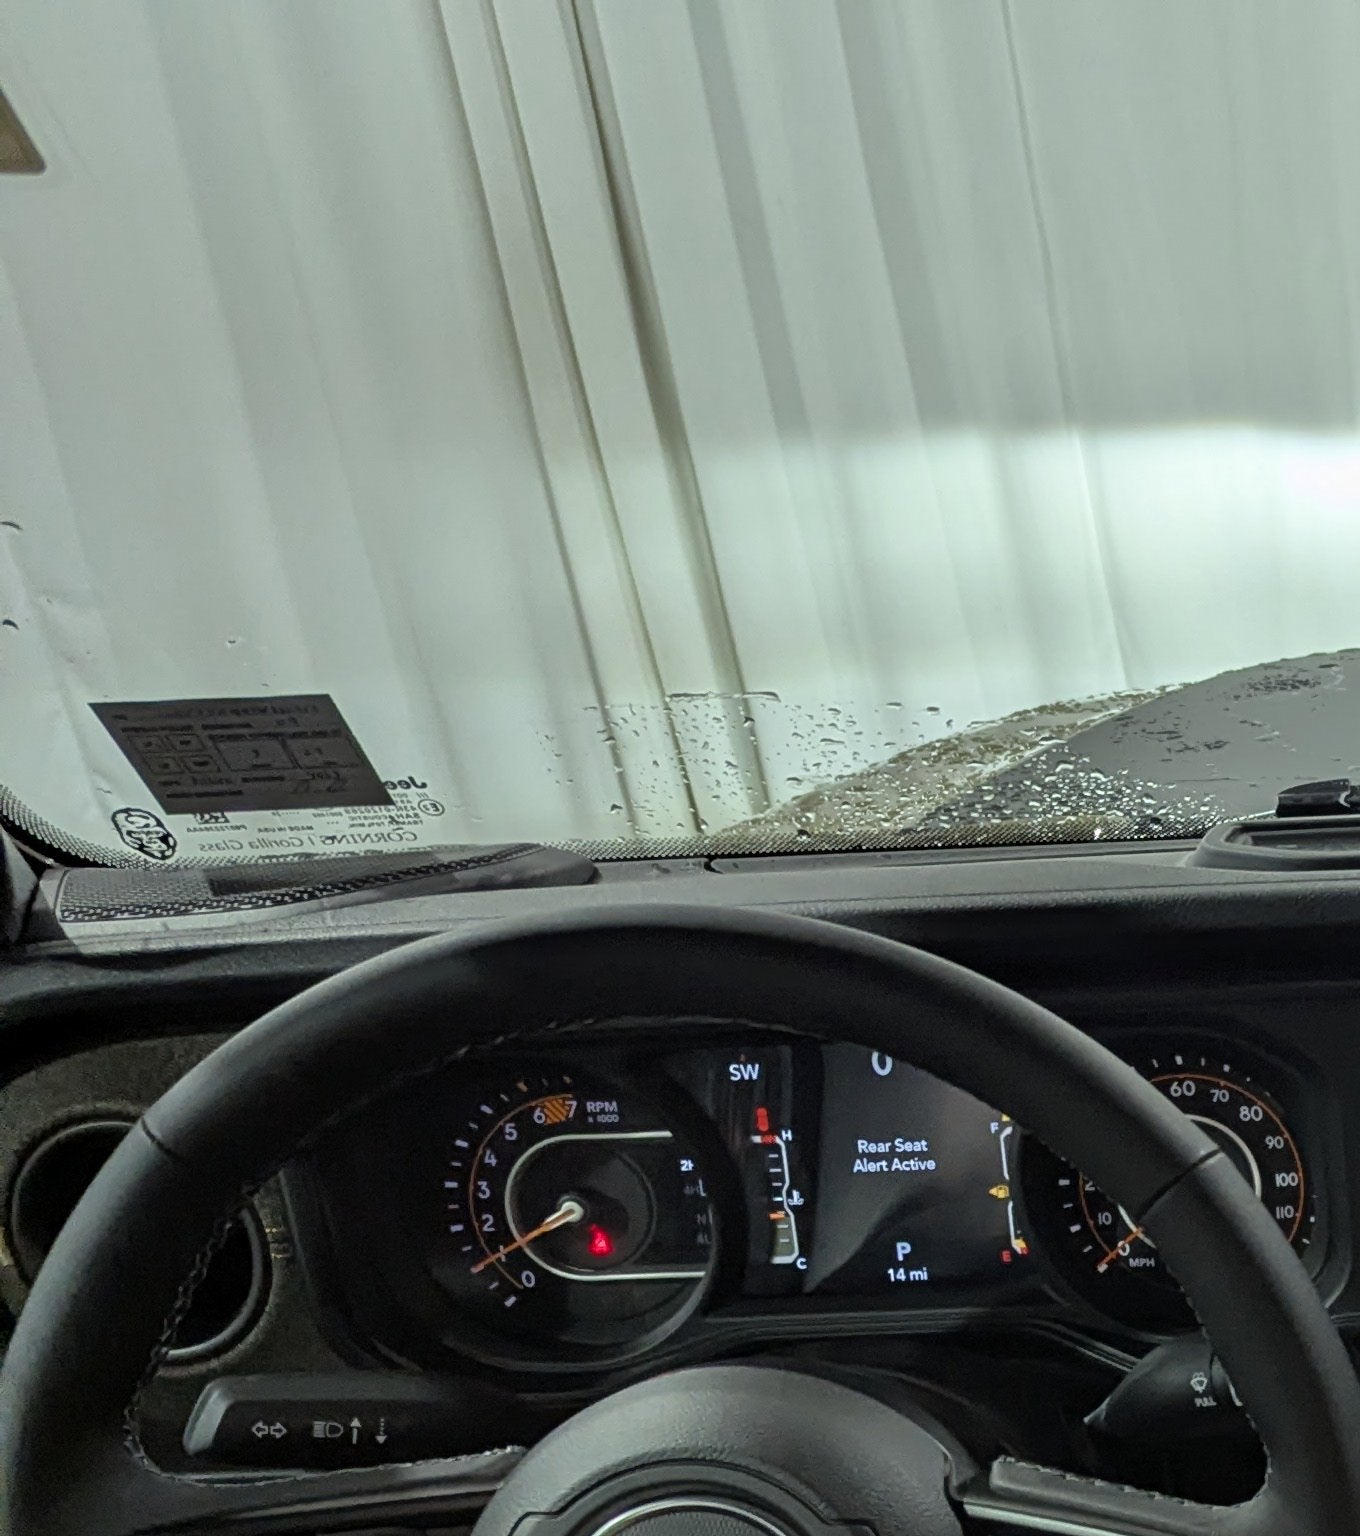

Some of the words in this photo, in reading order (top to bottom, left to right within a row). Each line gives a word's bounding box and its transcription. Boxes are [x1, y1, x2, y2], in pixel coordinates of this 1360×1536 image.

[729, 1063, 760, 1081] SW
[1170, 1081, 1196, 1097] 60
[1210, 1090, 1230, 1103] 70
[533, 1107, 546, 1124] 6
[565, 1100, 578, 1118] 7
[586, 1101, 619, 1113] RPM
[1239, 1105, 1263, 1122] 80
[504, 1123, 518, 1140] 5
[781, 1129, 793, 1141] H
[990, 1122, 999, 1134] F
[857, 1139, 891, 1154] Rear
[894, 1138, 928, 1152] Seat
[1265, 1136, 1285, 1149] 90
[485, 1150, 497, 1167] 4
[853, 1159, 888, 1173] Alert
[891, 1157, 936, 1171] Active
[1275, 1172, 1298, 1187] 100
[477, 1181, 490, 1199] 3
[1098, 1212, 1112, 1225] 10
[1275, 1205, 1294, 1219] 110
[482, 1214, 495, 1232] 2
[896, 1242, 912, 1261] P
[1002, 1251, 1012, 1262] E
[796, 1258, 807, 1270] C
[1129, 1258, 1155, 1268] MPH
[521, 1270, 535, 1287] 0
[888, 1268, 906, 1282] 14
[909, 1266, 928, 1281] mi
